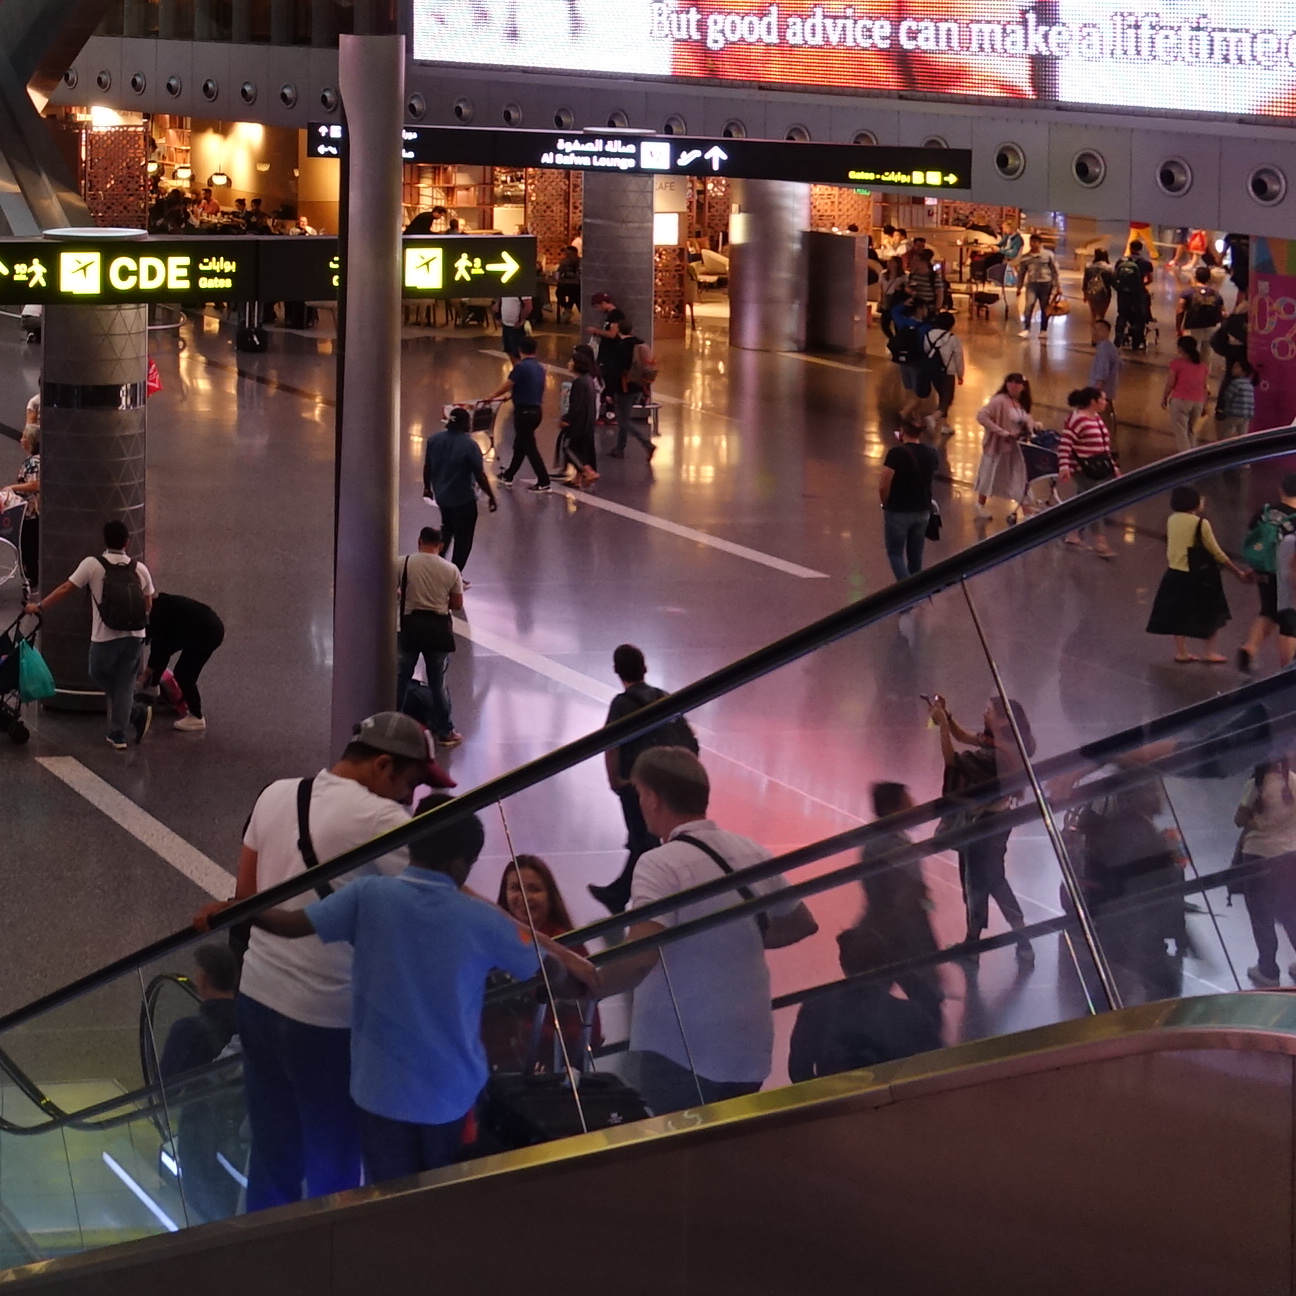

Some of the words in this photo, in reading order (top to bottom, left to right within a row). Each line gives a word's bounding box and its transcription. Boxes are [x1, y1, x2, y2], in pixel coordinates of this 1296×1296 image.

[650, 0, 701, 41] But
[707, 3, 779, 50] good
[786, 4, 892, 49] advice
[899, 18, 960, 51] can
[968, 8, 1072, 58] make
[1080, 22, 1105, 61] a
[1109, 11, 1280, 71] lifetime
[541, 152, 554, 164] Al
[555, 153, 591, 166] Safwa
[592, 155, 636, 170] Lounge
[109, 256, 190, 290] CDE
[198, 256, 236, 273] بوابات
[198, 276, 232, 288] Gates
